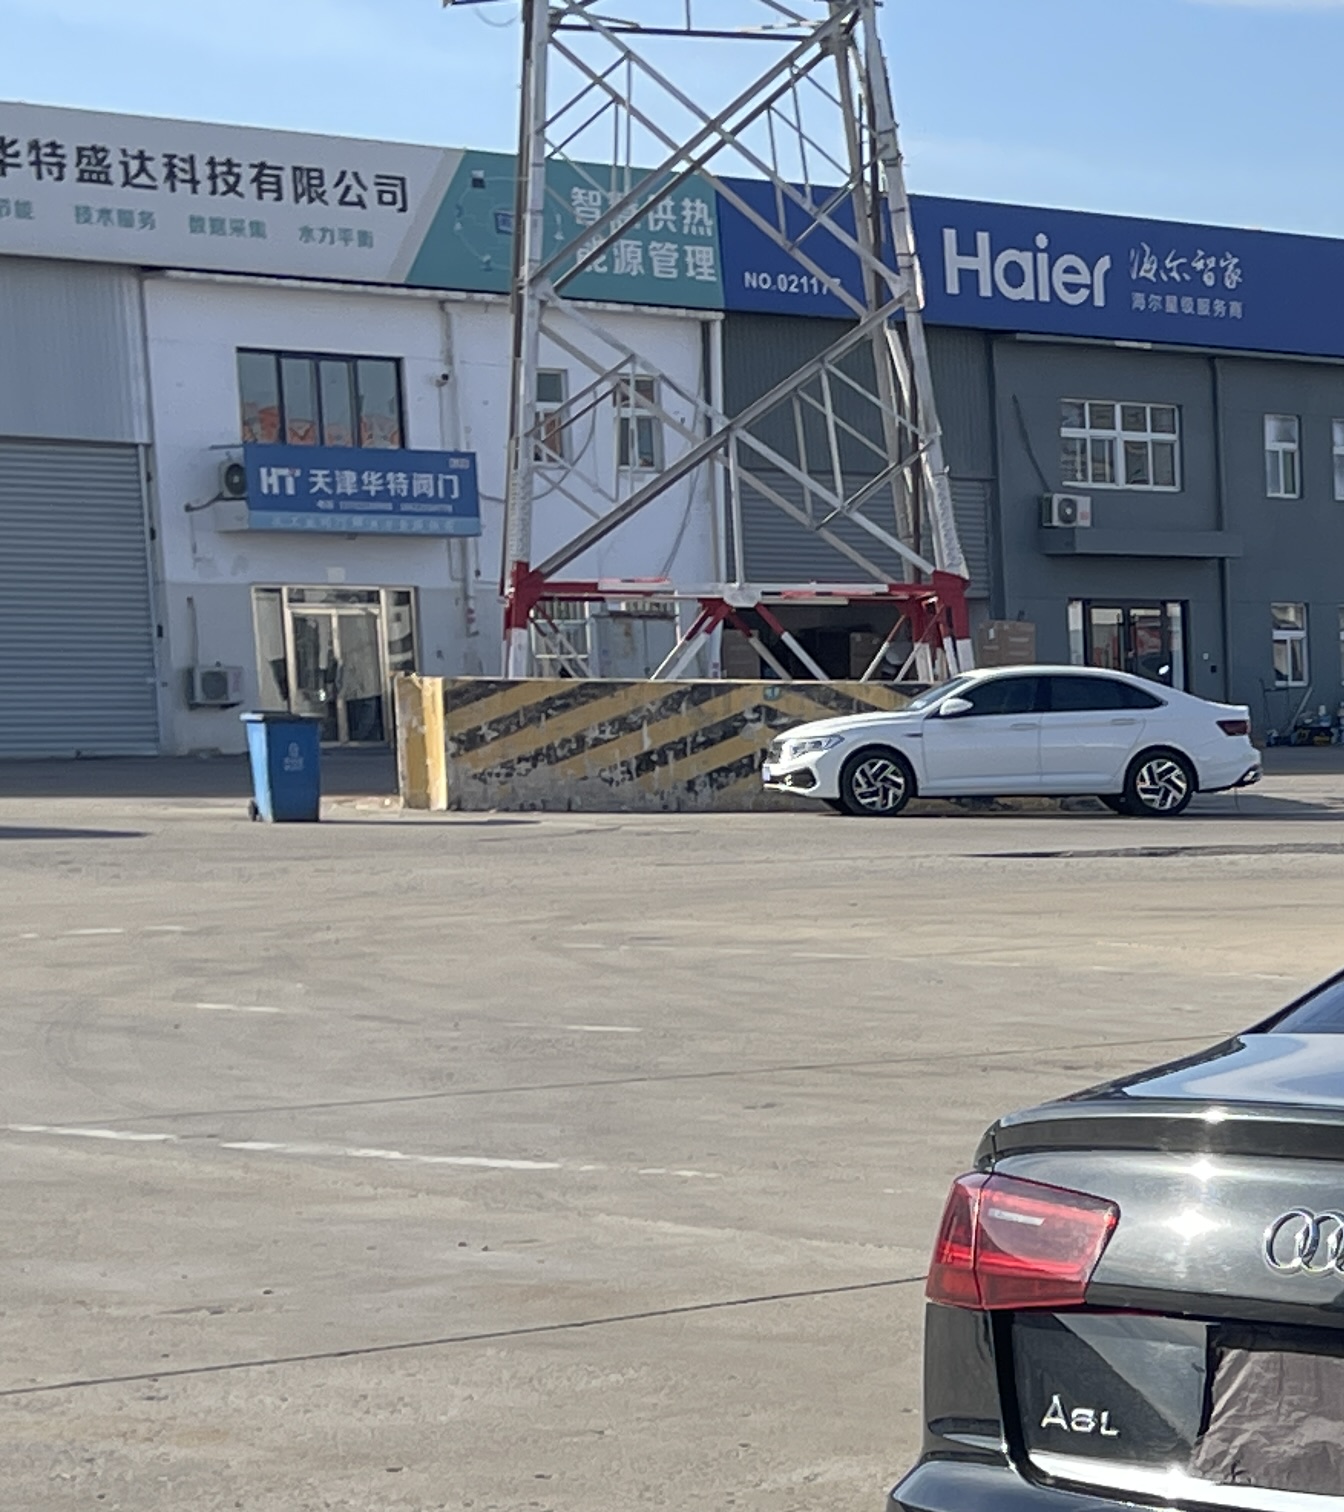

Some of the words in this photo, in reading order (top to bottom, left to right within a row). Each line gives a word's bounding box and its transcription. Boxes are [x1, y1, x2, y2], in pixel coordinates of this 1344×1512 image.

[298, 225, 374, 249] 水力平衡
[942, 228, 1112, 307] Haier
[1129, 242, 1243, 290] 海尔智家
[308, 468, 460, 500] 天津华特阀门
[1040, 1393, 1119, 1436] A6L
